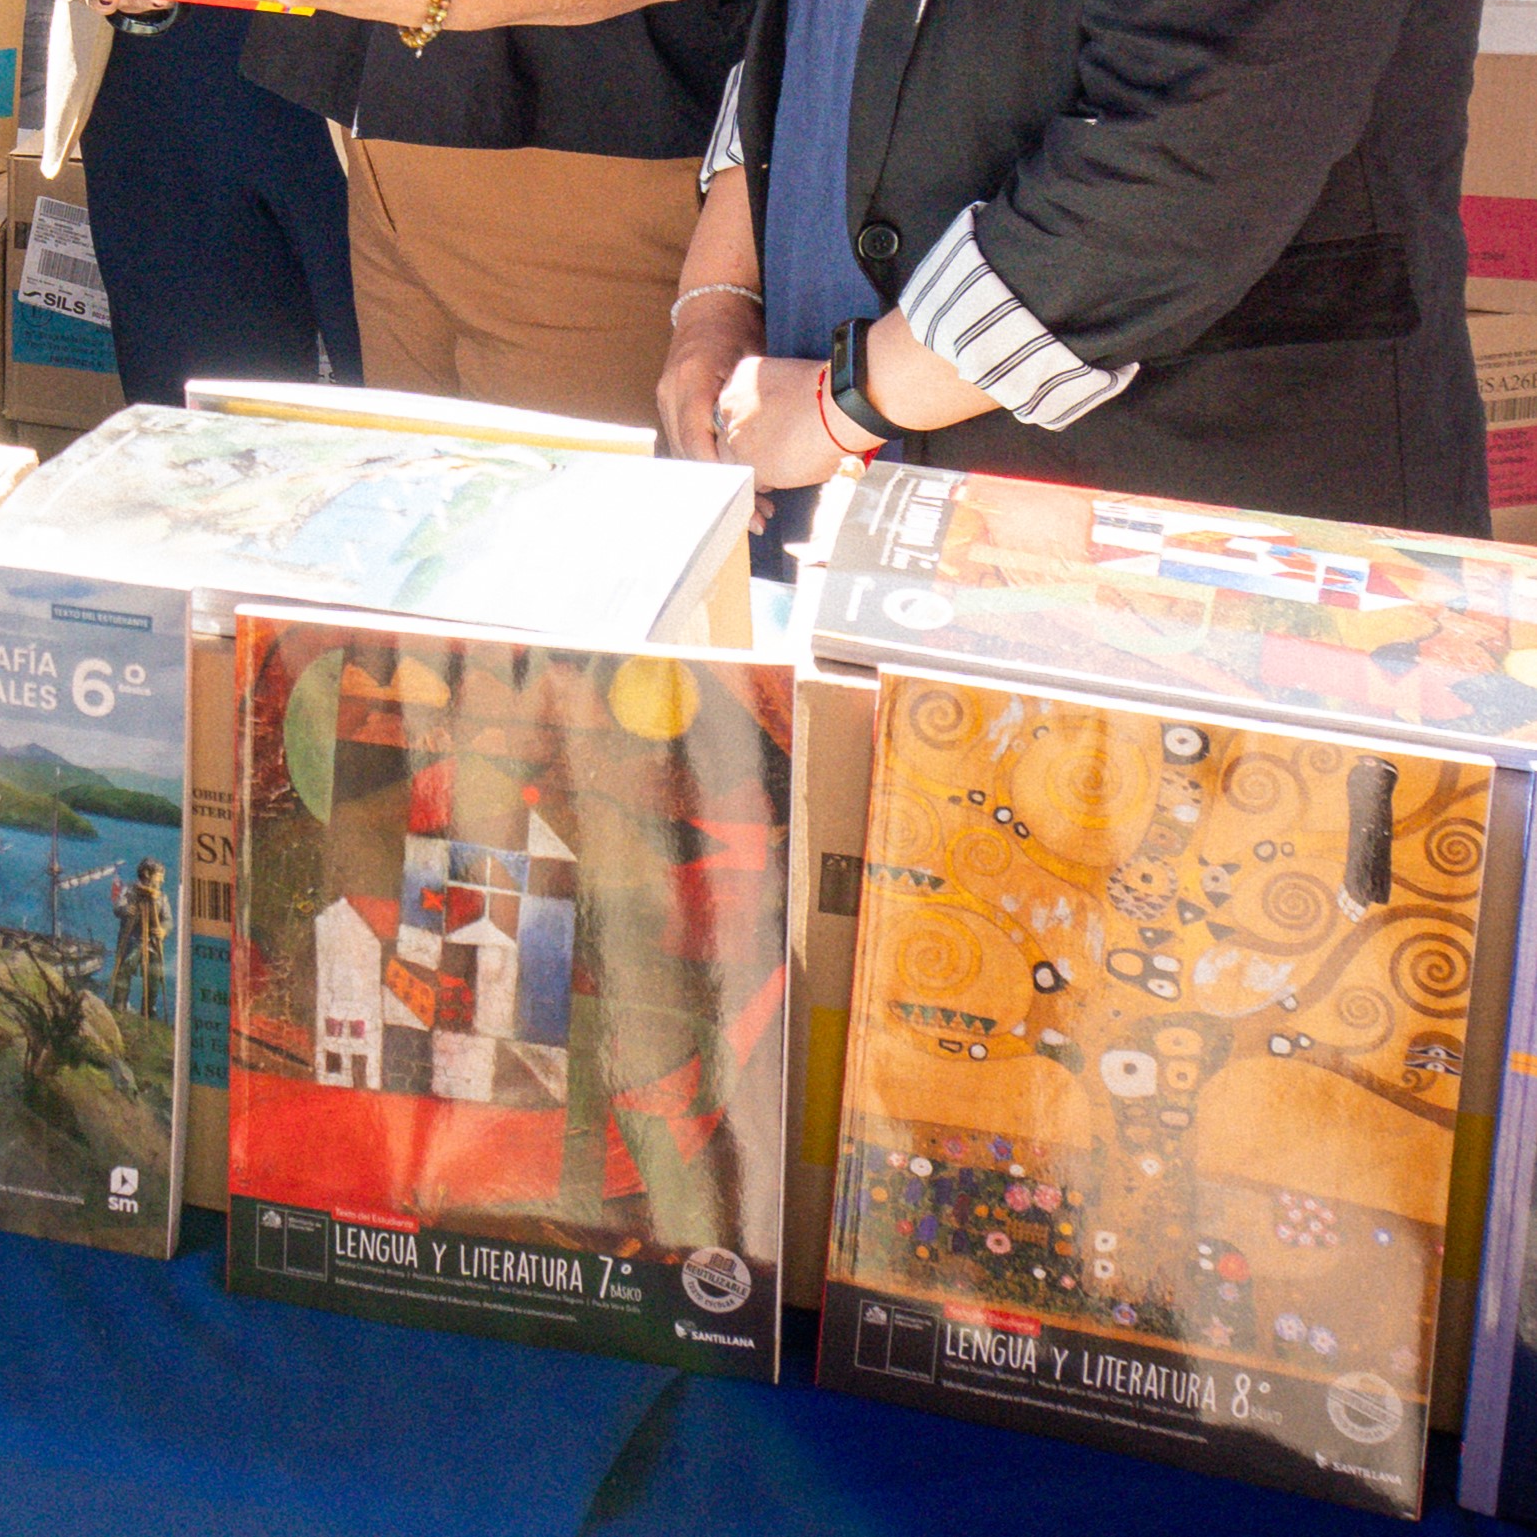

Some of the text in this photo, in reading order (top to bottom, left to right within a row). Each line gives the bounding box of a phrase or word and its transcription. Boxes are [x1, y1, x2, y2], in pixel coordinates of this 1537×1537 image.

[43, 292, 86, 315] SILS
[108, 1194, 139, 1214] sm
[334, 1223, 418, 1269] LENGUA
[432, 1241, 447, 1275] Y
[459, 1244, 584, 1293] LITERATURA
[684, 1263, 748, 1298] REUTILIZABLE
[690, 1330, 756, 1350] SANTILLANA
[945, 1323, 1037, 1374] LENGUA
[1052, 1347, 1069, 1380] Y
[1082, 1350, 1217, 1413] LITERATURA
[1331, 1460, 1403, 1486] SANTILLANA
